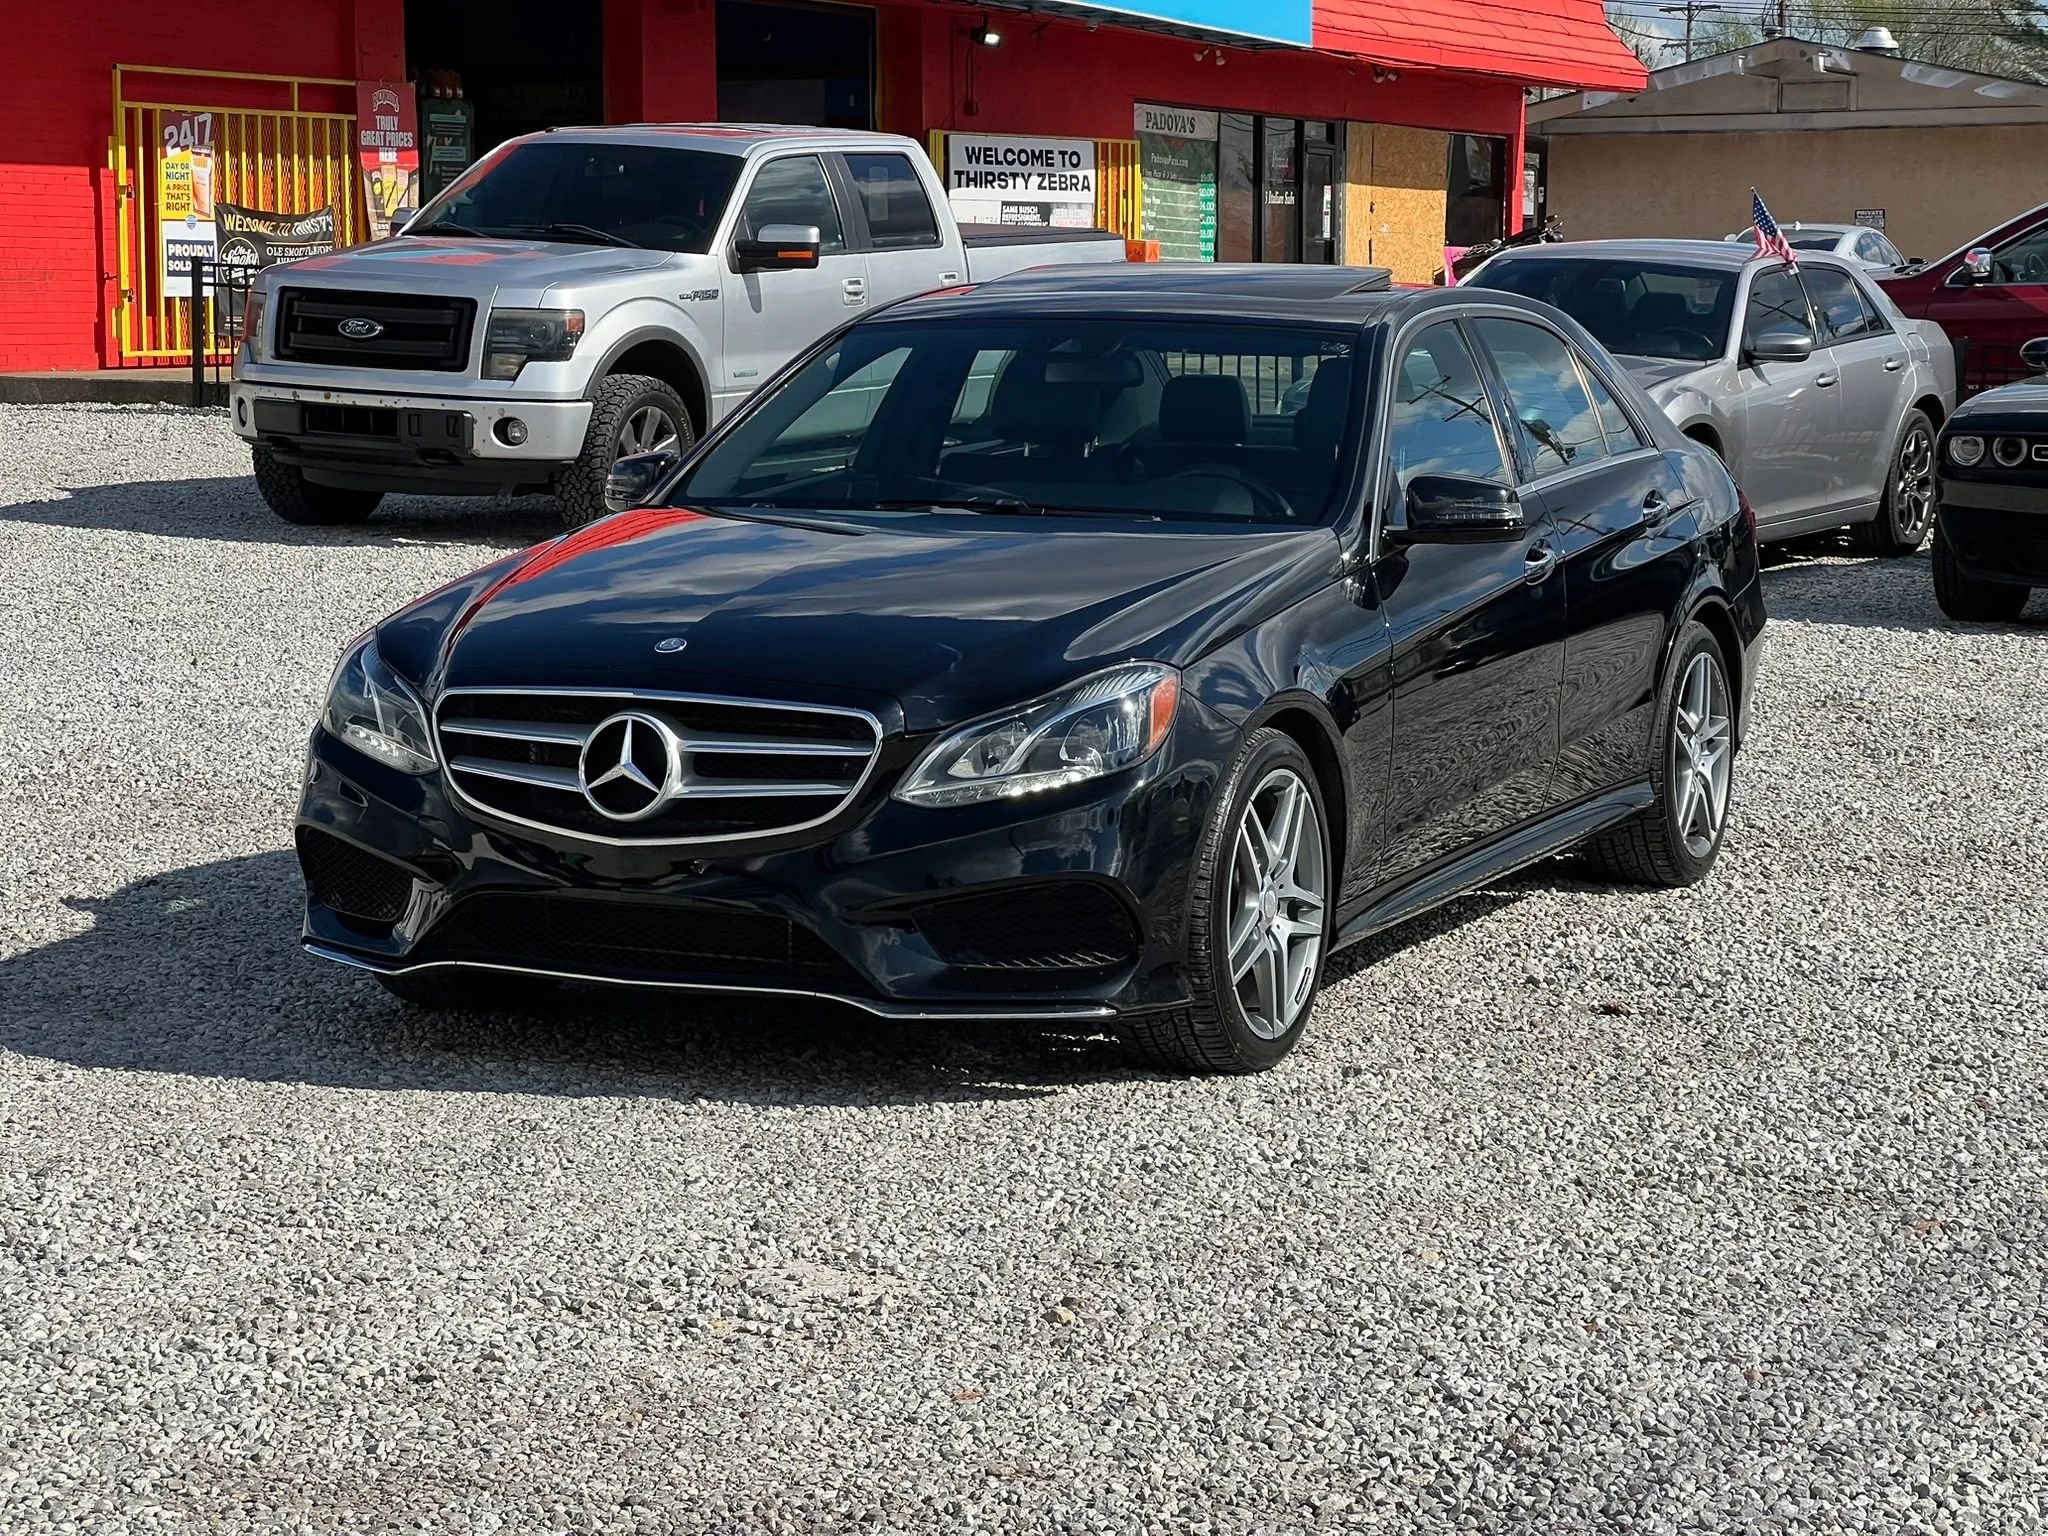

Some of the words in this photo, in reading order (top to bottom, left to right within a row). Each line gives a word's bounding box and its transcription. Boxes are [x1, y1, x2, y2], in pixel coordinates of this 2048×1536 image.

[376, 115, 398, 131] TRULY
[1145, 111, 1196, 134] PADOVA'S
[361, 130, 384, 146] GREAT
[386, 132, 413, 147] PRICES
[379, 148, 398, 162] HERE
[965, 146, 1055, 167] WELCOME
[1058, 150, 1081, 169] TO
[165, 162, 179, 170] DAY
[165, 171, 190, 180] NIGHT
[954, 170, 1032, 190] THIRSTY
[1037, 173, 1091, 192] ZEBRA
[166, 193, 191, 201] THAT'S
[166, 202, 191, 211] RIGHT
[1002, 205, 1018, 213] SAME
[224, 214, 275, 236] WELCOME
[277, 222, 292, 237] TO
[168, 244, 213, 257] PROUDLY
[266, 246, 282, 256] OLE
[168, 260, 192, 271] SOLD
[345, 320, 370, 333] Ford
